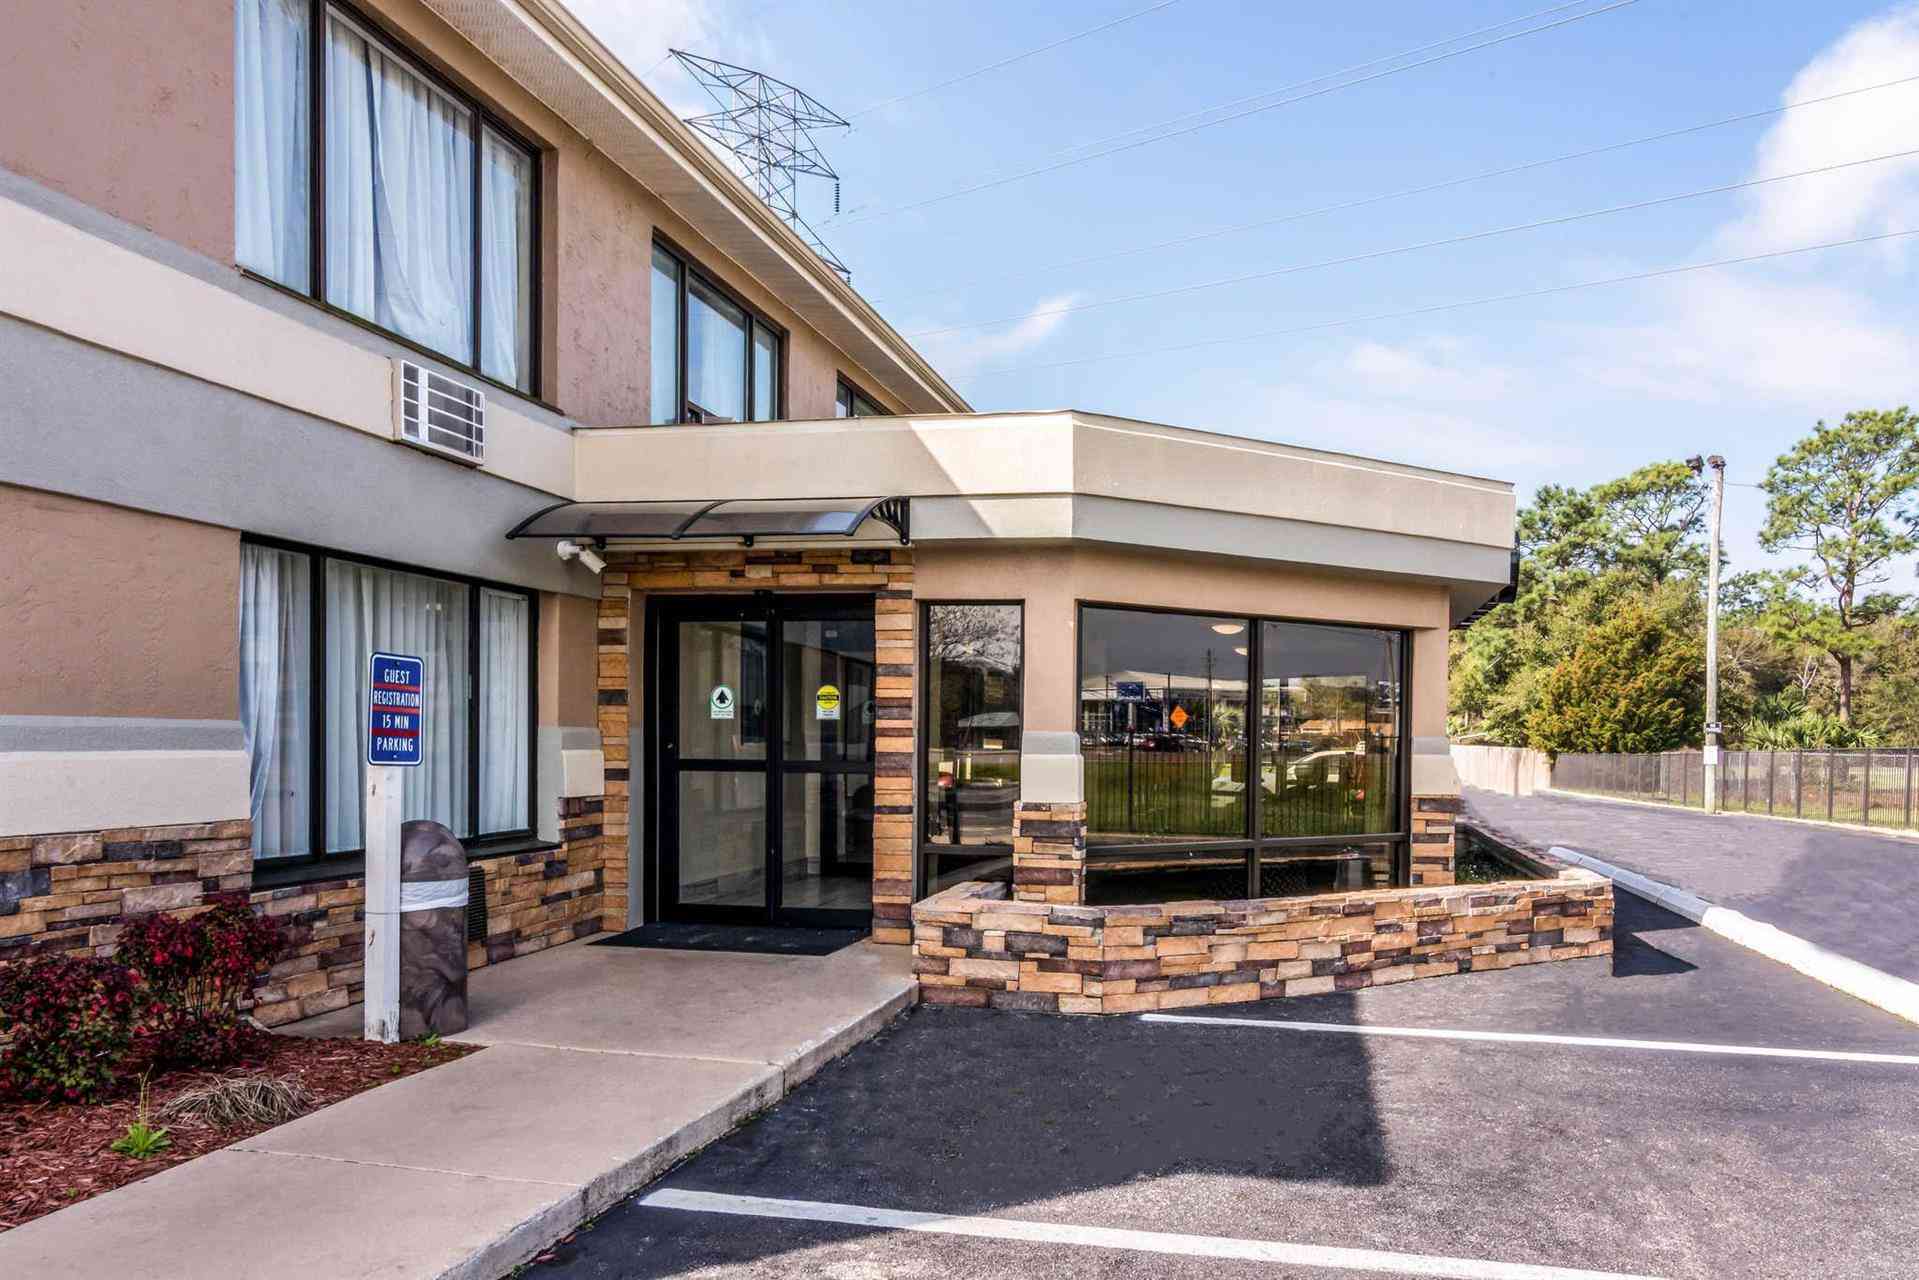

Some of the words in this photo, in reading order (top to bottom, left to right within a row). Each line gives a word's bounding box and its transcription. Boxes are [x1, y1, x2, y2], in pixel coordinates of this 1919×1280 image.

[384, 669, 410, 684] GUEST
[373, 691, 419, 707] REGISTRATION
[382, 714, 391, 728] 15
[395, 715, 409, 729] MIN
[376, 737, 413, 752] PARKING
